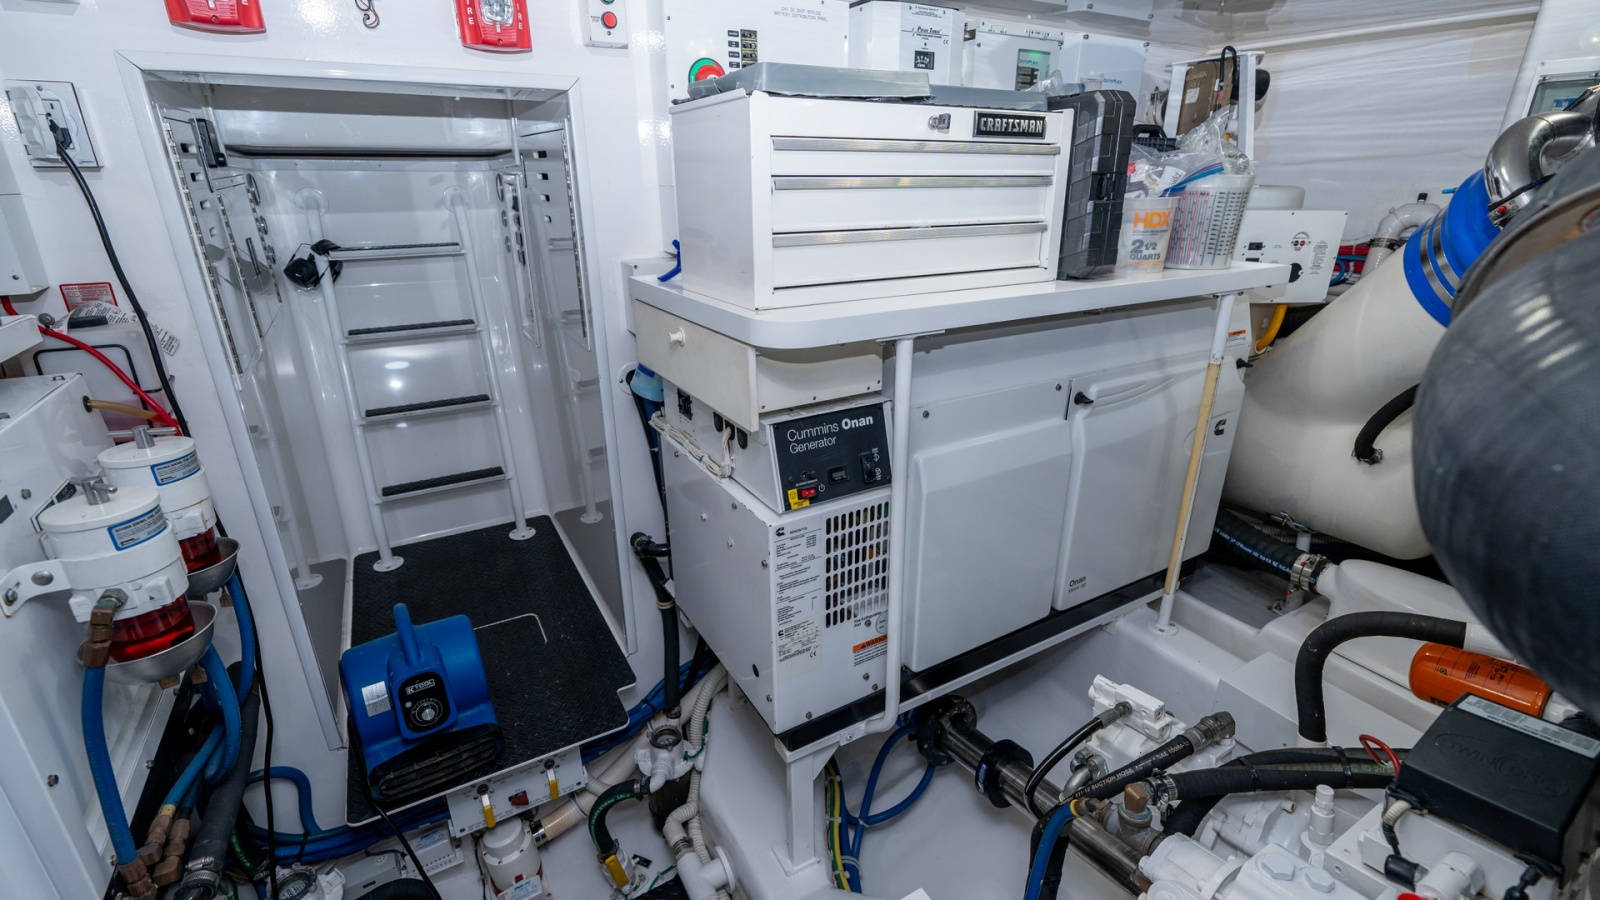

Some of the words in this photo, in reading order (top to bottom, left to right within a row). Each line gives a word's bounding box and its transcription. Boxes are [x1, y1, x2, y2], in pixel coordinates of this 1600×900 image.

[466, 0, 474, 25] IRE
[791, 12, 816, 20] DISTRIBUTION
[980, 117, 1043, 133] CRAFTSMAN
[1133, 211, 1171, 228] HDX
[1130, 239, 1144, 254] 2
[1144, 242, 1157, 251] 1/2
[1129, 253, 1161, 261] QUARTS
[787, 423, 839, 442] Cummins
[841, 416, 874, 430] Onan
[789, 436, 837, 454] Generator
[1069, 576, 1087, 587] Onan
[865, 634, 887, 648] WARNIN
[1156, 750, 1168, 760] SAE
[1091, 776, 1116, 790] SUCTION
[1116, 768, 1134, 780] HOSE
